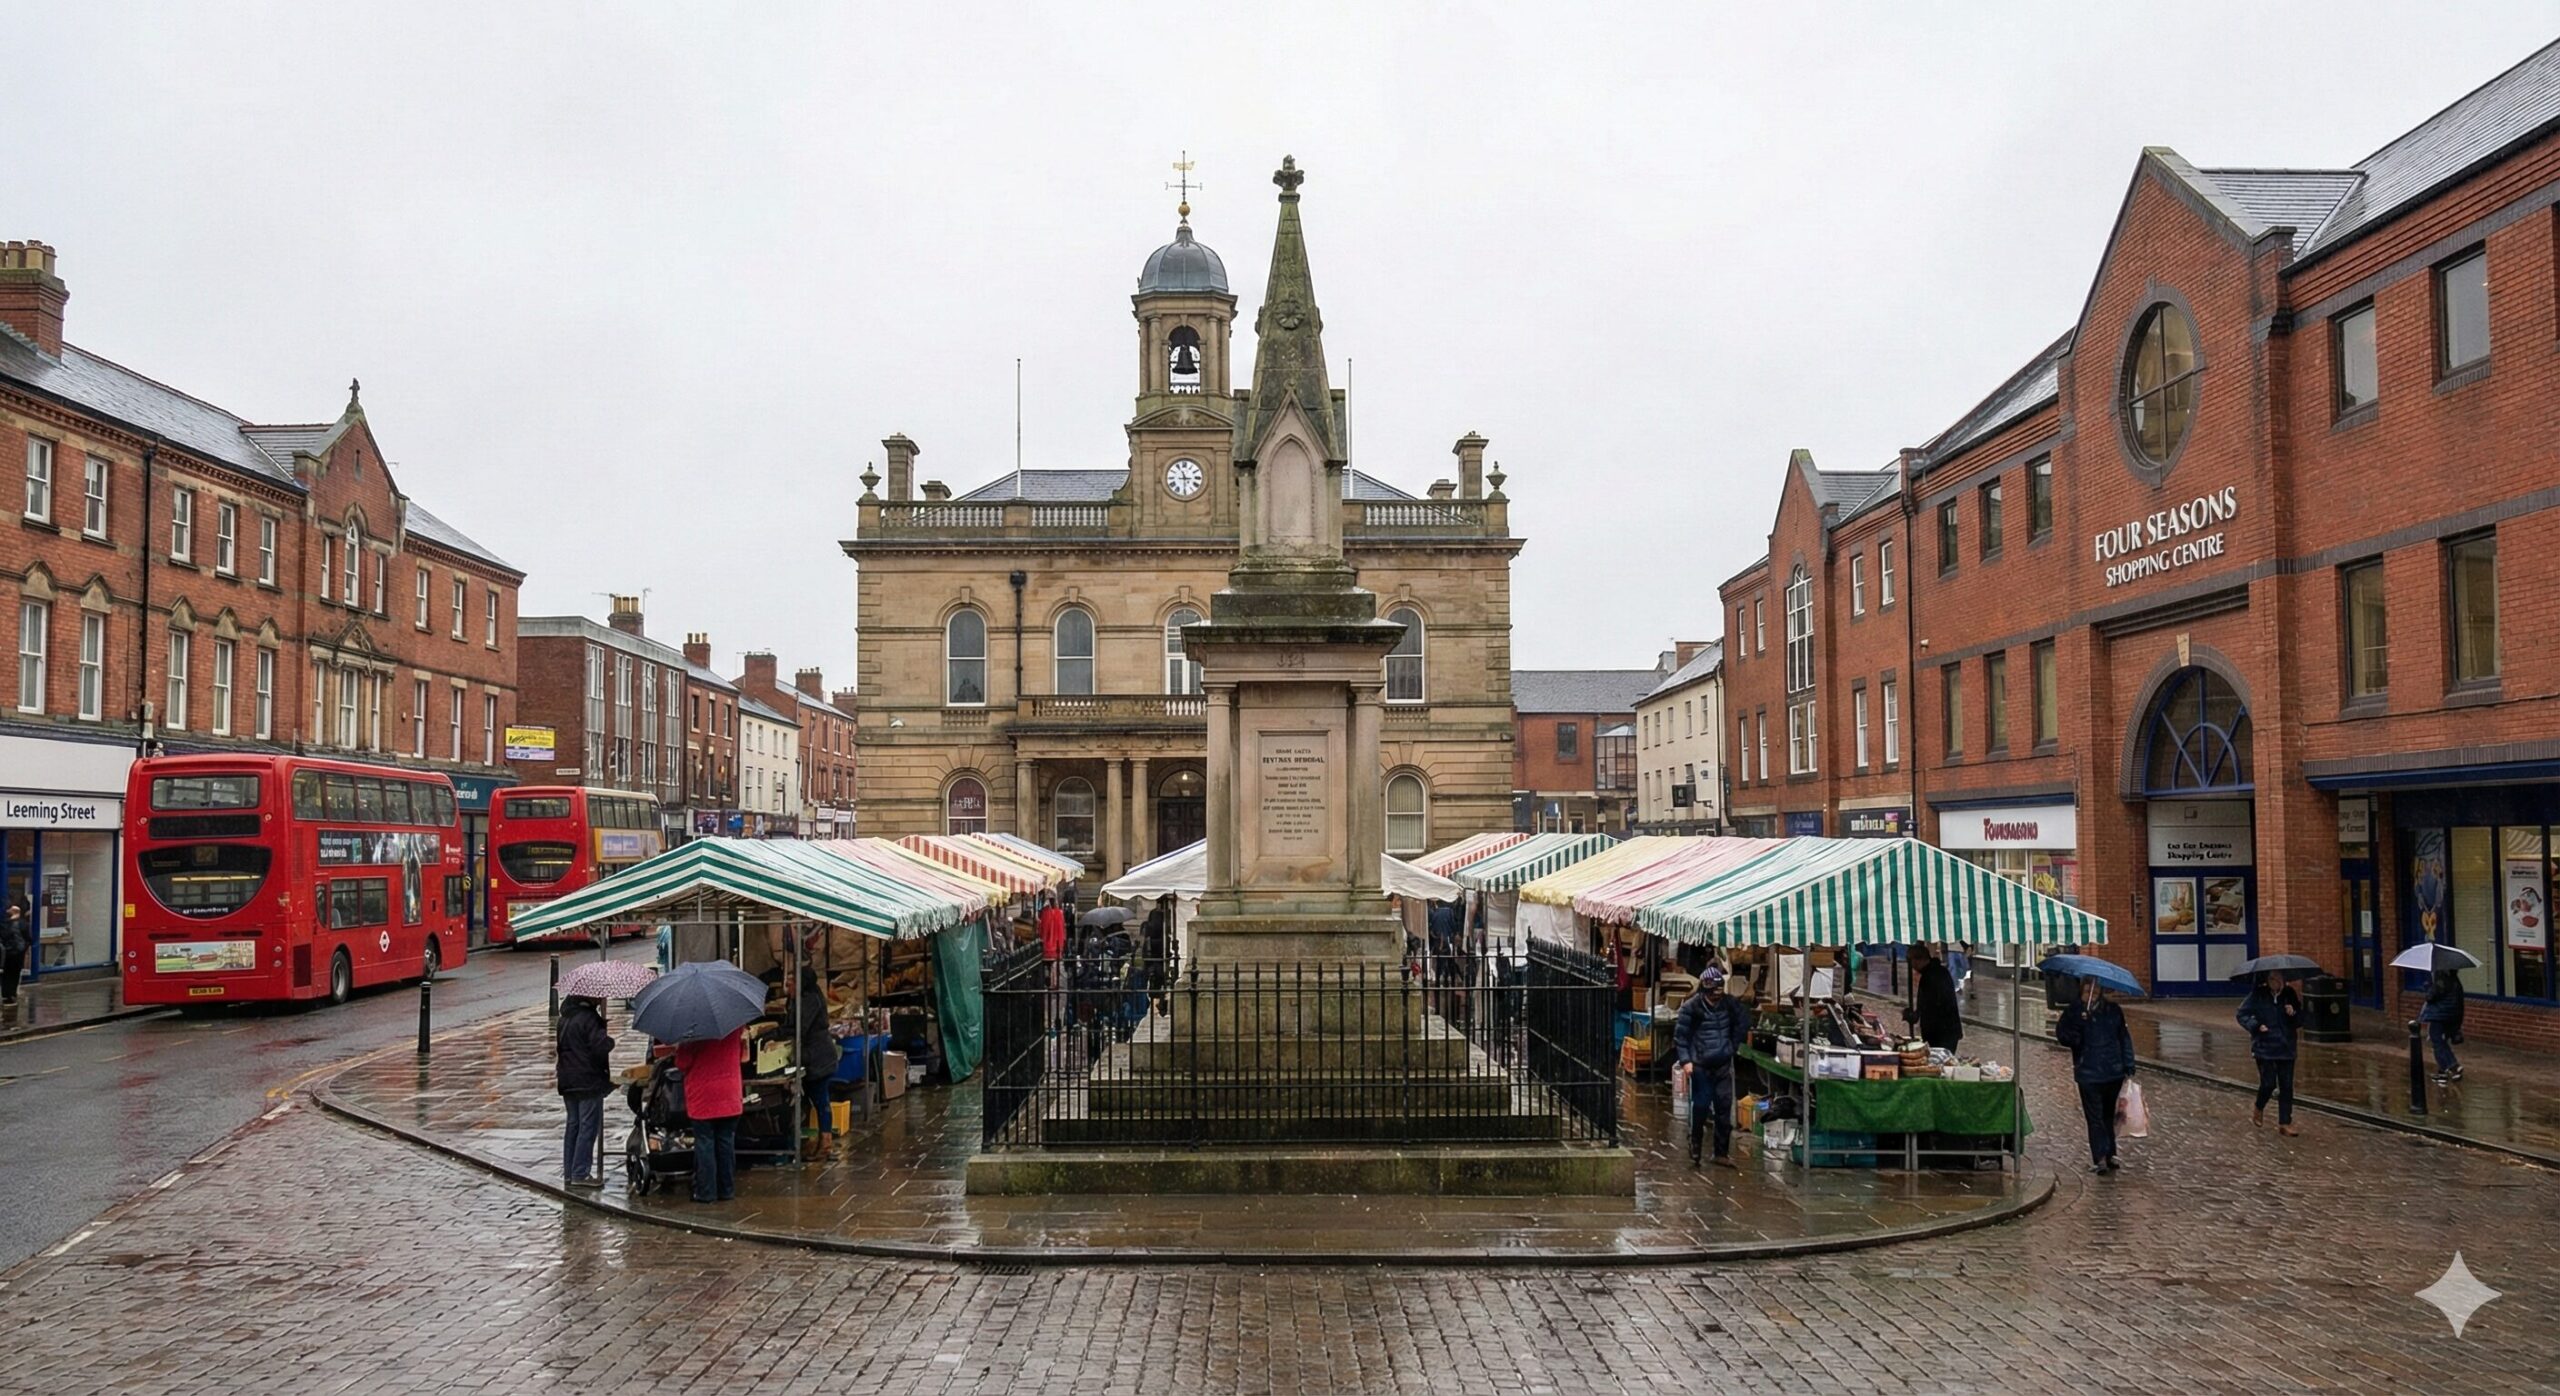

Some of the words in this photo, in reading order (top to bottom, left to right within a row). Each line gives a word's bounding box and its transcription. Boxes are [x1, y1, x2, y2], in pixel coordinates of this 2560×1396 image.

[2094, 520, 2143, 562] FOUR
[2147, 486, 2237, 545] SEASONS
[2105, 550, 2170, 587] SHOPPING
[2172, 533, 2225, 567] CENTRE
[6, 800, 58, 824] Leeming
[60, 802, 96, 820] Street
